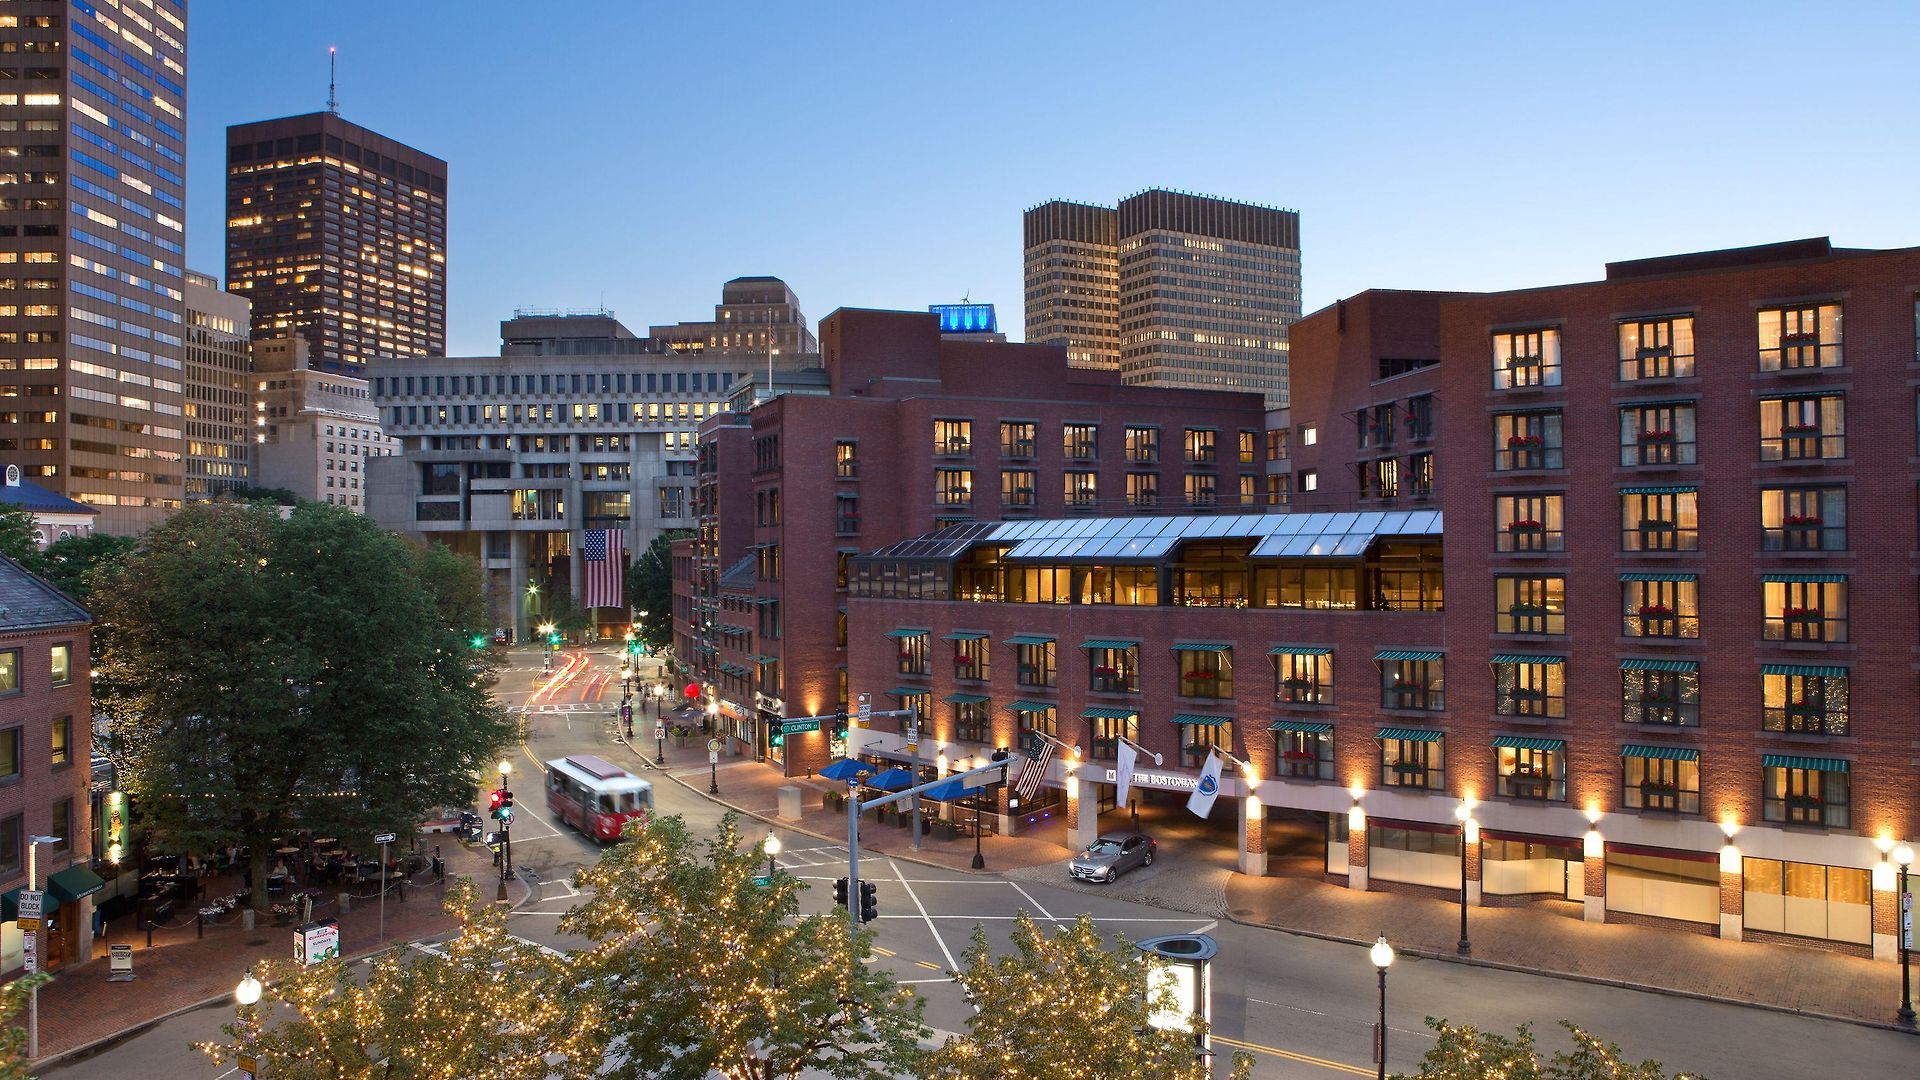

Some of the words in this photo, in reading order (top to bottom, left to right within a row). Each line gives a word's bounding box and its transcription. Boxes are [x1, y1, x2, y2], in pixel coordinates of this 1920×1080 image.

[1133, 773, 1149, 783] THE
[1150, 775, 1198, 788] BOSTONIAN
[20, 893, 29, 901] DO
[30, 893, 41, 902] NOT
[20, 902, 40, 910] BLOCK
